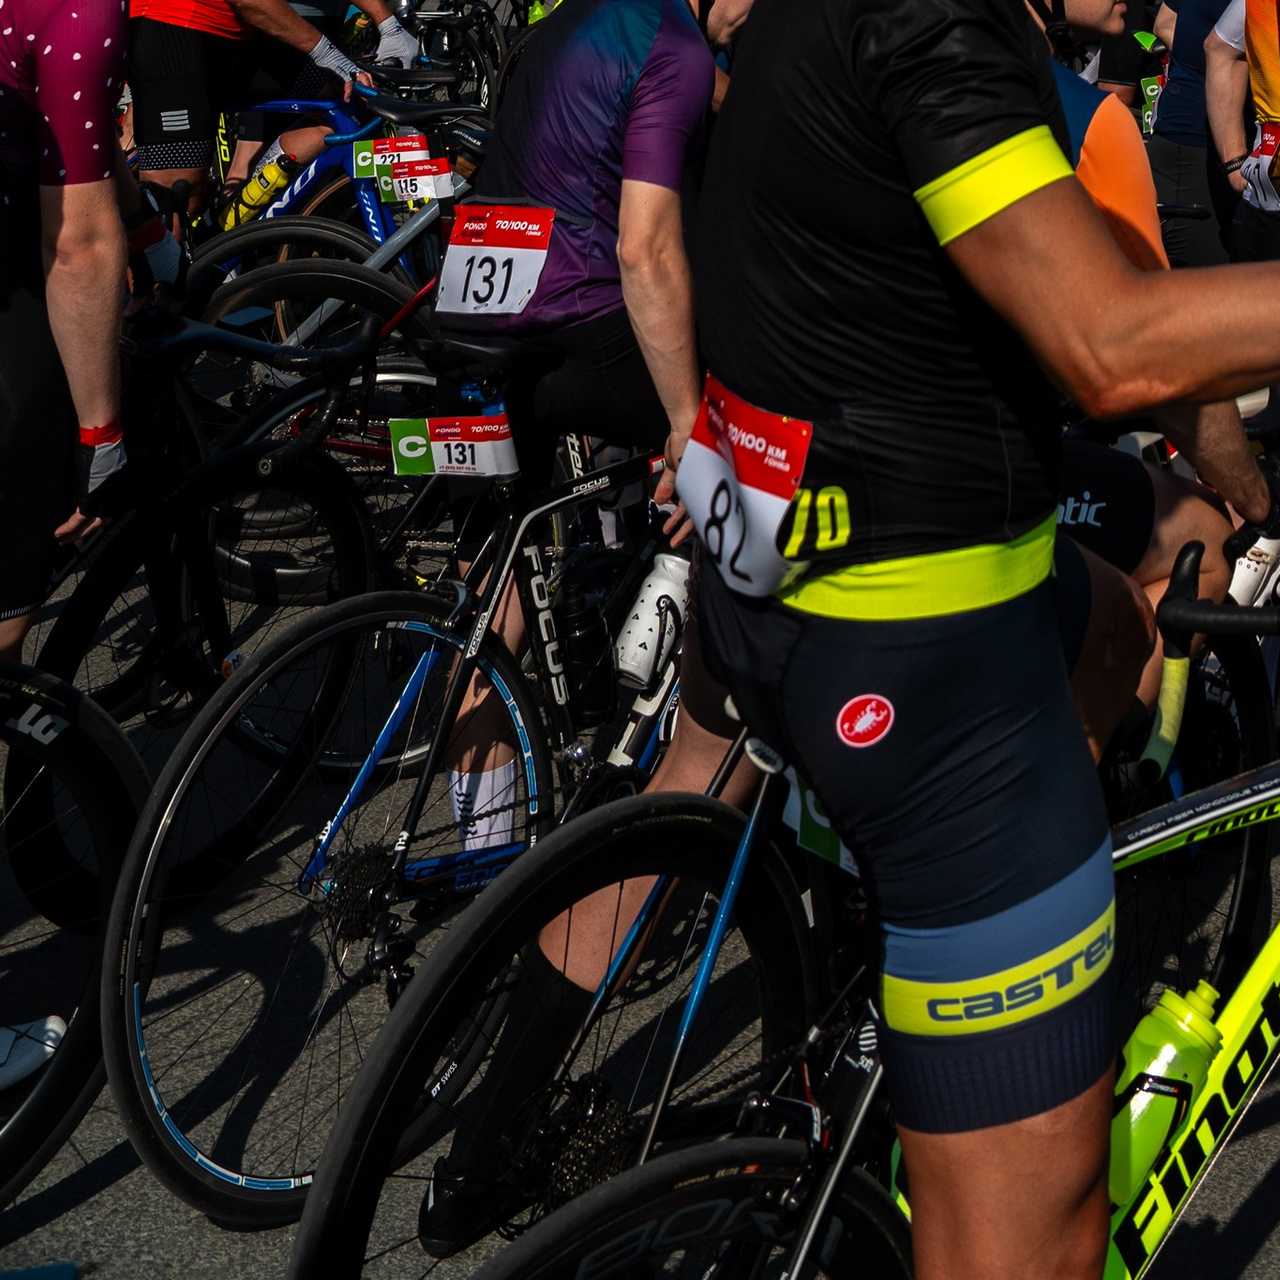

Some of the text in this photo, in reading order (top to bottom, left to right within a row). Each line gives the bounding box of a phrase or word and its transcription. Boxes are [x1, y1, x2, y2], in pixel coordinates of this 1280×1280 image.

[463, 222, 488, 230] FONDO
[495, 220, 528, 231] 70/100
[461, 255, 514, 305] 131
[471, 424, 499, 433] 70/100
[398, 435, 427, 458] C
[443, 442, 476, 466] 131
[572, 475, 610, 494] FOCUS
[468, 613, 488, 657] FOCUS
[522, 544, 570, 707] FOCUS
[1127, 820, 1167, 841] CARBON
[1167, 809, 1195, 824] FIBER
[441, 1061, 459, 1085] SWISS
